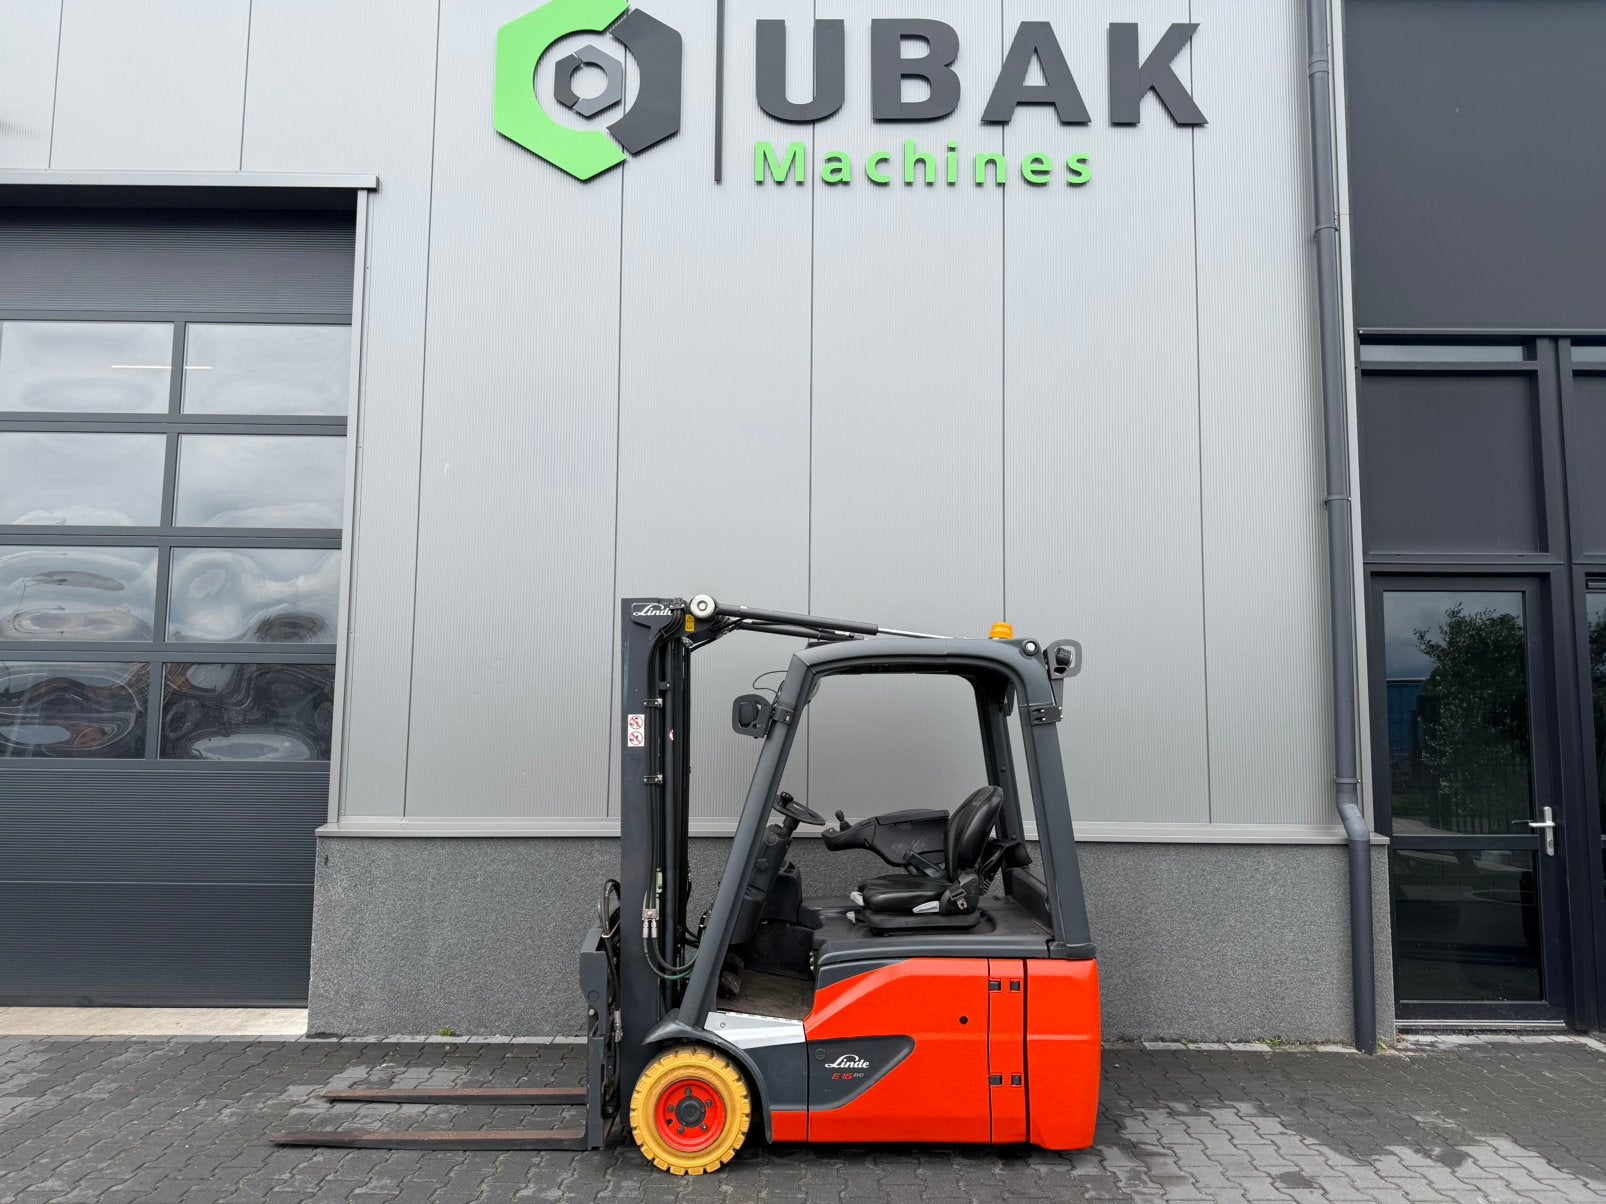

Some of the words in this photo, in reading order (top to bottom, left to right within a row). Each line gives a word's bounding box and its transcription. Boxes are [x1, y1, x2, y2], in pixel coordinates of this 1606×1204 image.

[755, 18, 1209, 125] UBAK
[753, 140, 1093, 187] Machines
[825, 1054, 870, 1069] Linde
